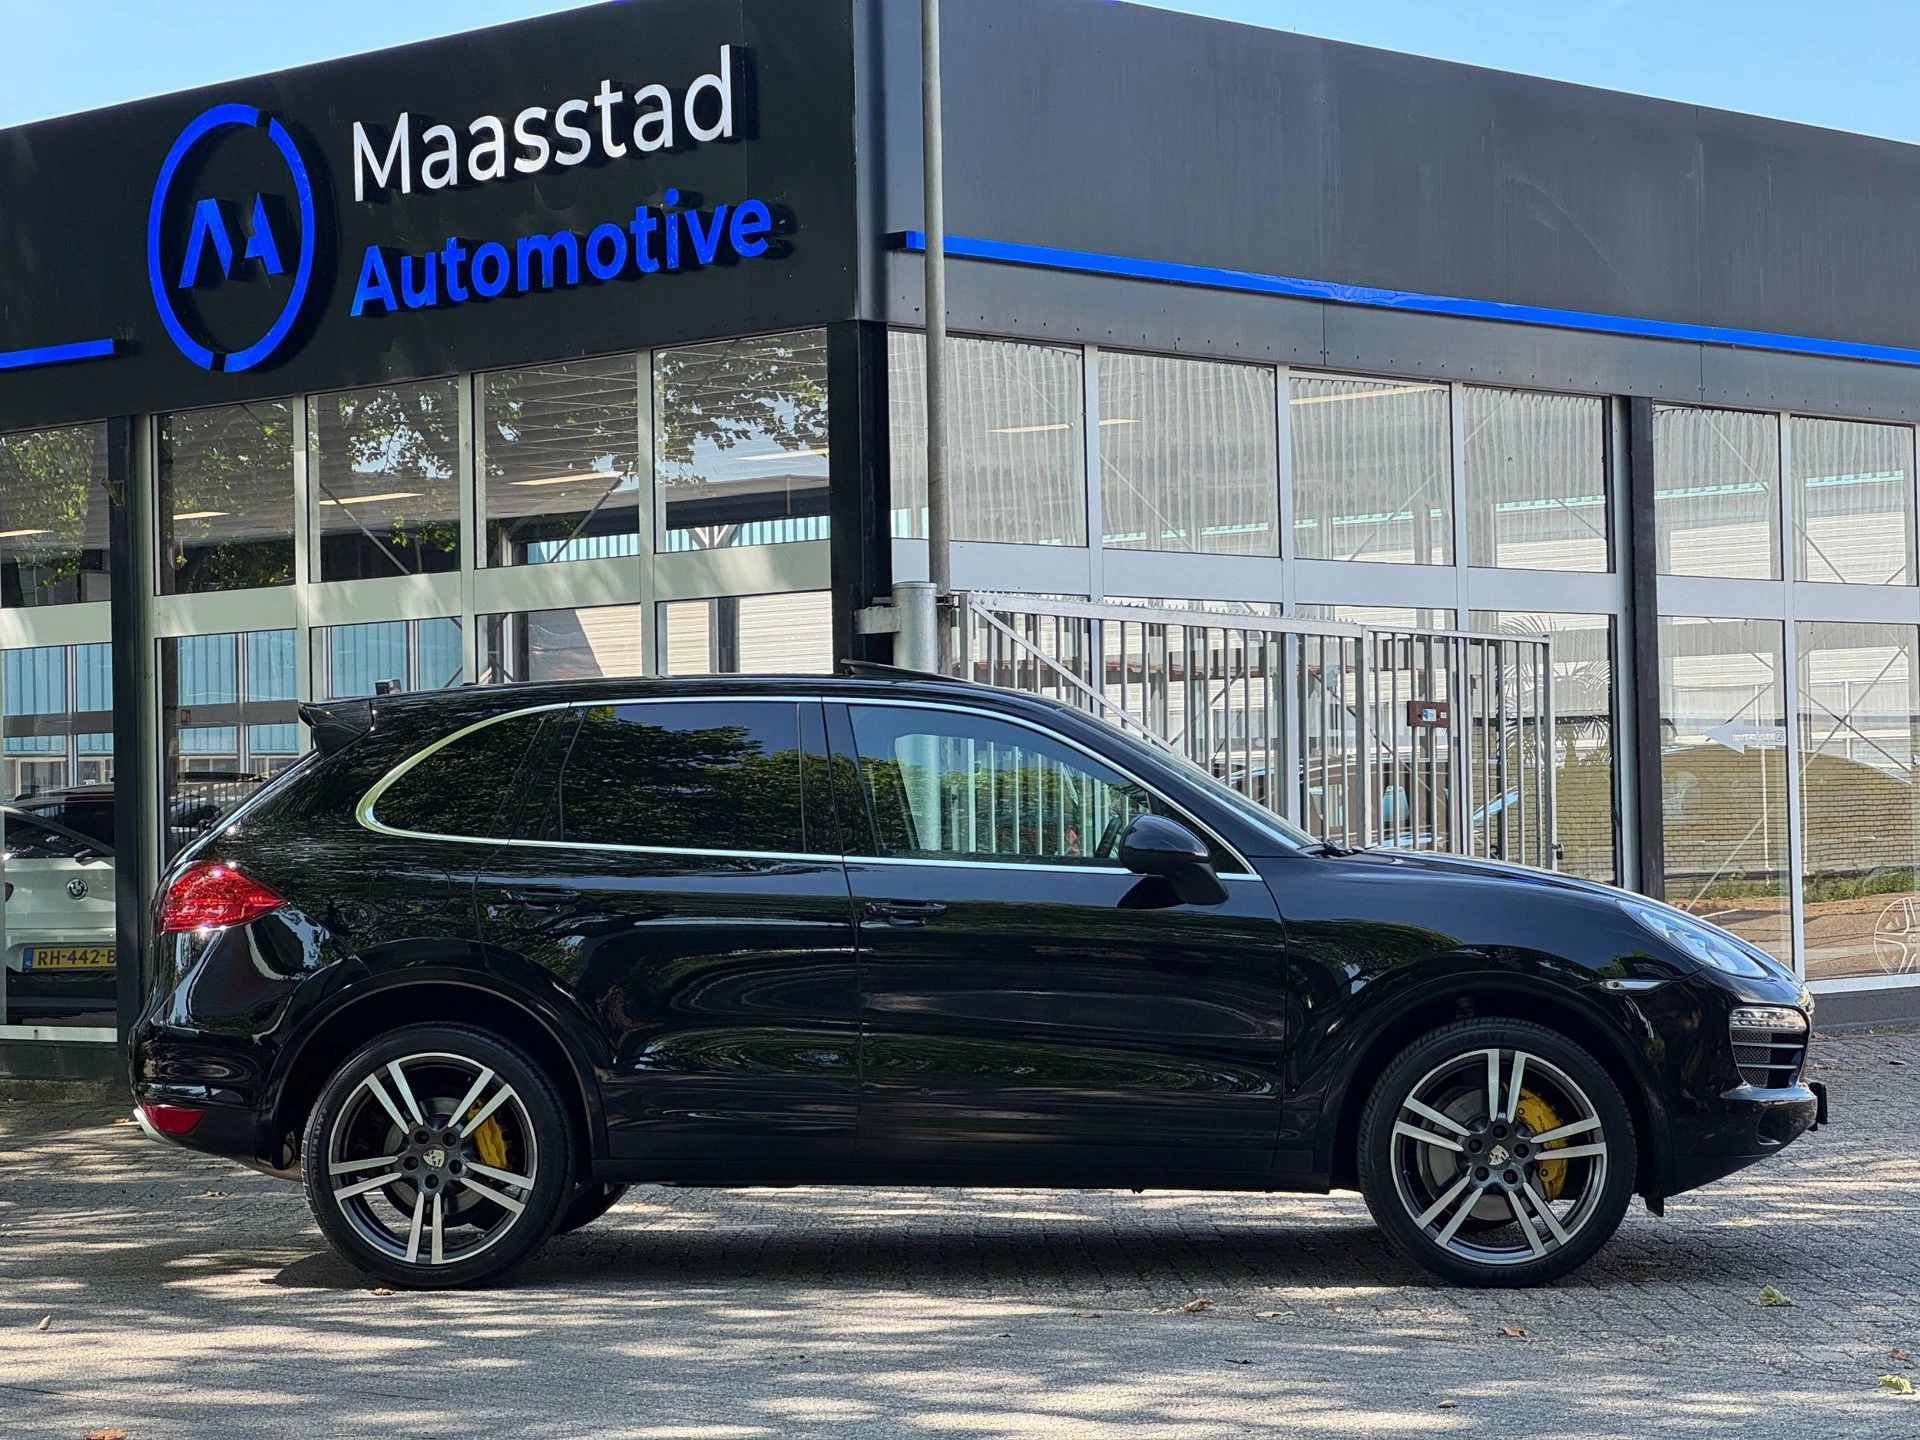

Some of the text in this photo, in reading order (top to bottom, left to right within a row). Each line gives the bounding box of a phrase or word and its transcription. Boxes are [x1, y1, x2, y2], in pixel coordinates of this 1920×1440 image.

[352, 43, 733, 203] Maasstad
[350, 187, 772, 317] Automotive
[37, 949, 116, 966] RH-442-B
